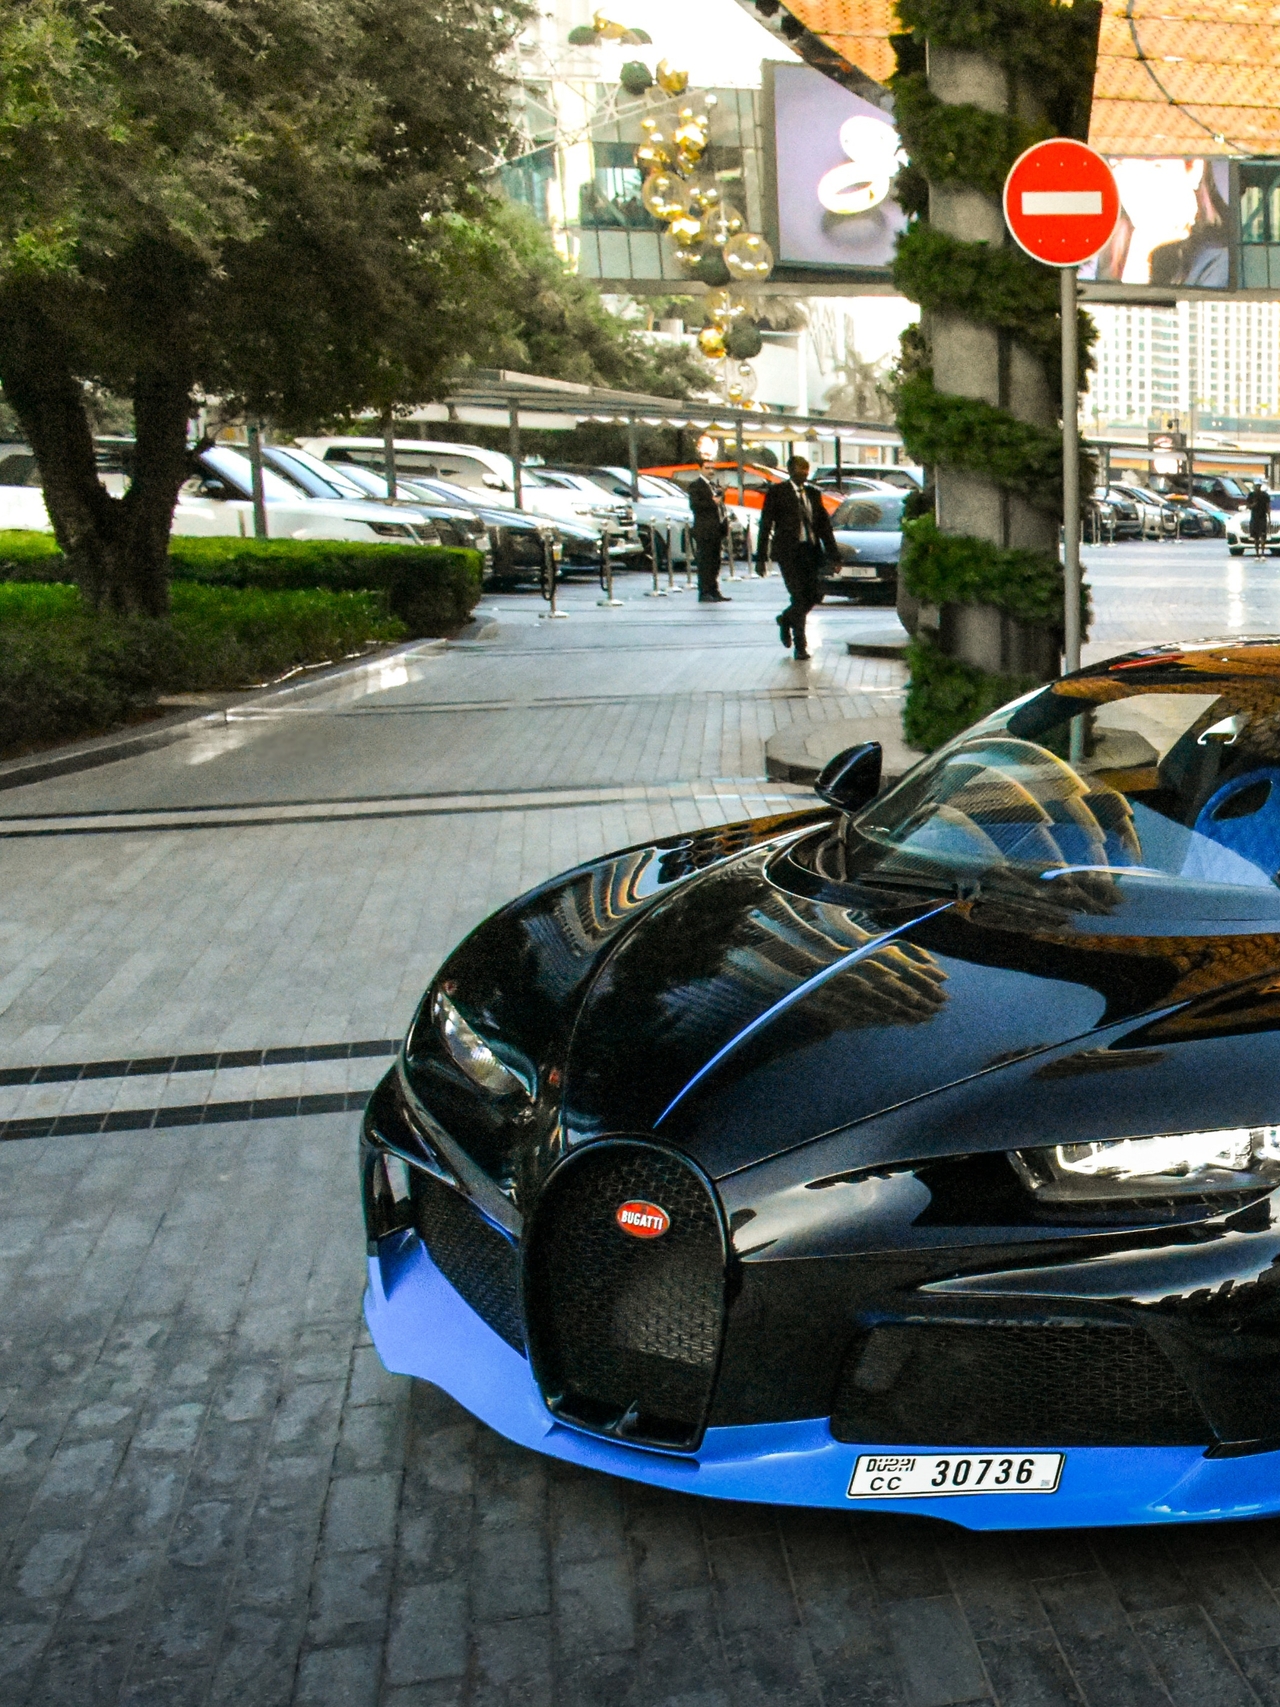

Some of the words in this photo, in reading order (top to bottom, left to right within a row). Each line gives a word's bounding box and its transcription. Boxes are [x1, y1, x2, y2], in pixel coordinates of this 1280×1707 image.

[621, 1210, 664, 1230] BUGATTI
[931, 1458, 1035, 1488] 30736
[869, 1476, 902, 1491] CC
